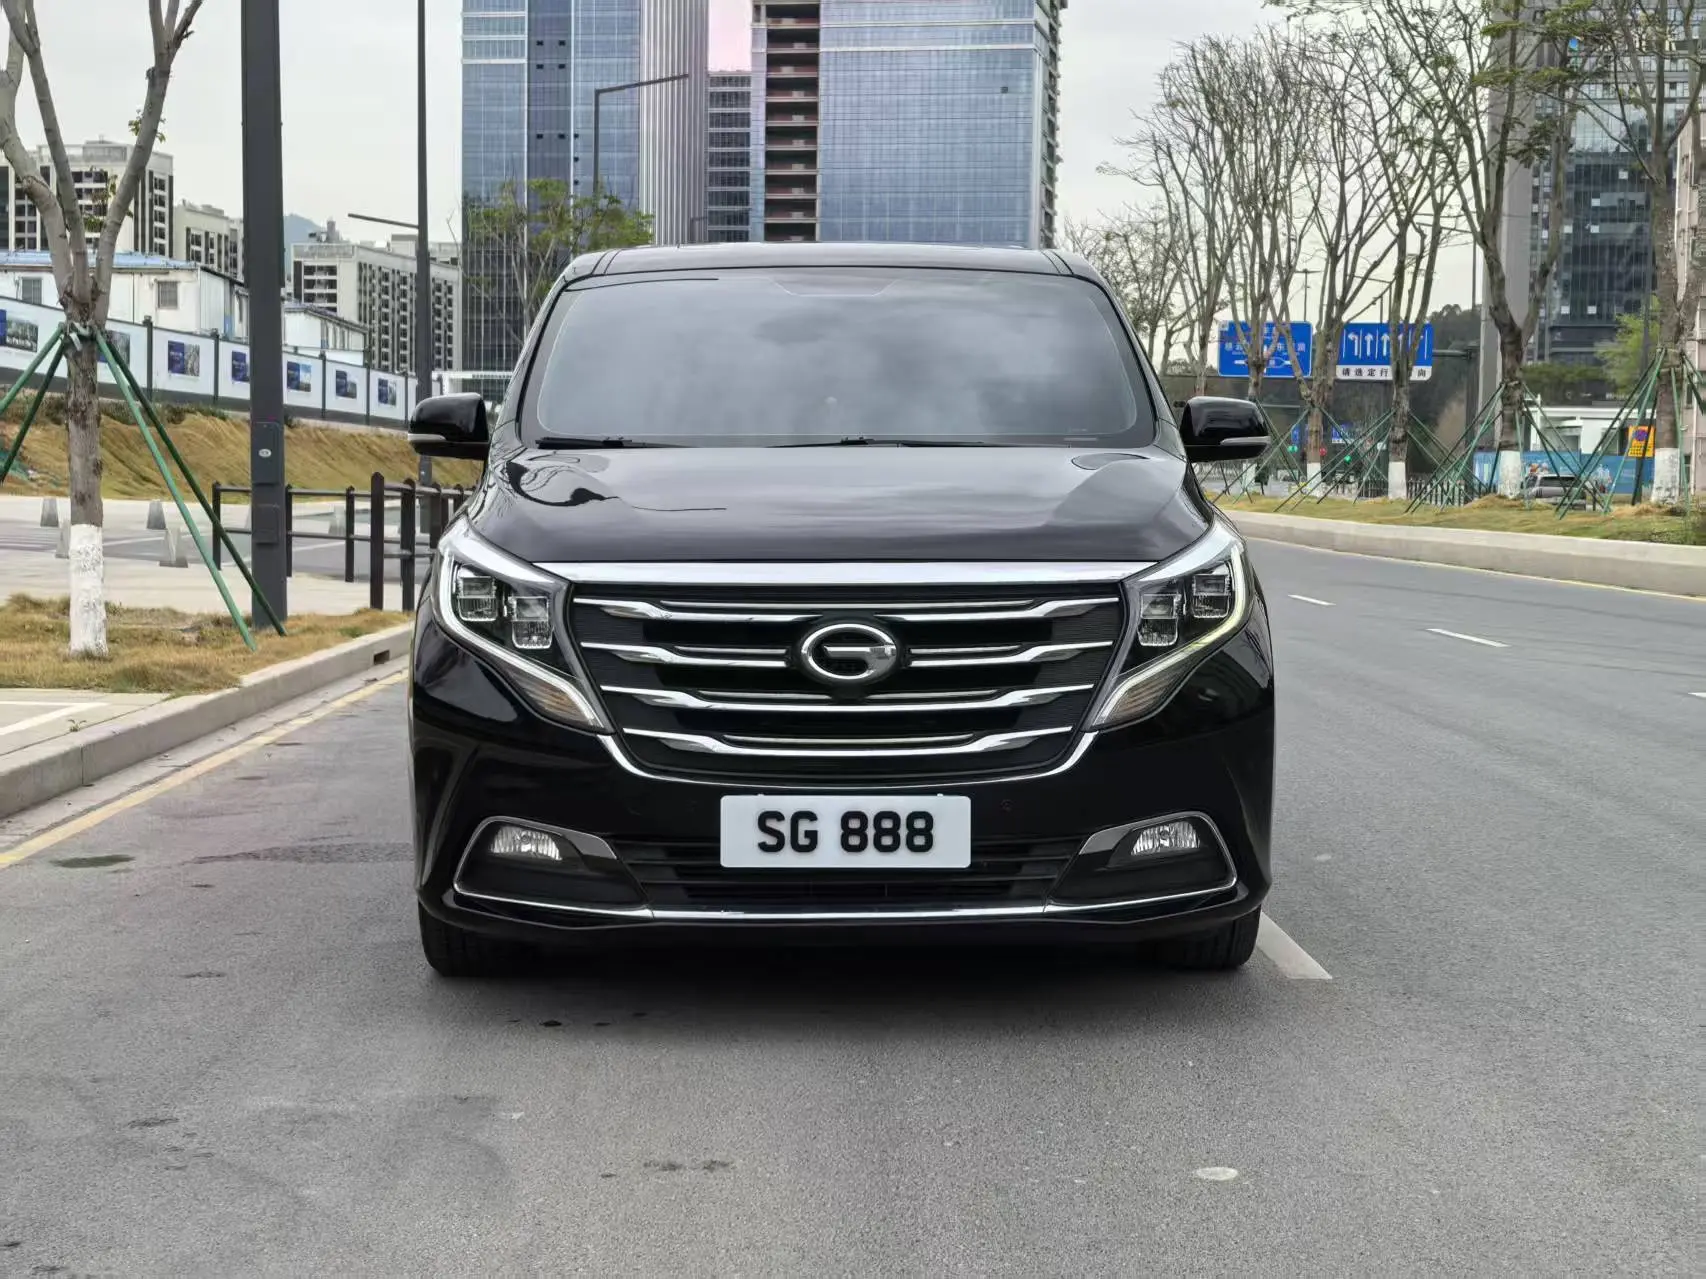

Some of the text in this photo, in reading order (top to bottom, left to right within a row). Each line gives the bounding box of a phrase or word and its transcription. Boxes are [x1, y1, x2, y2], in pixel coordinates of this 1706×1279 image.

[1342, 367, 1427, 377] 请选定行向
[757, 810, 934, 853] SG 888
